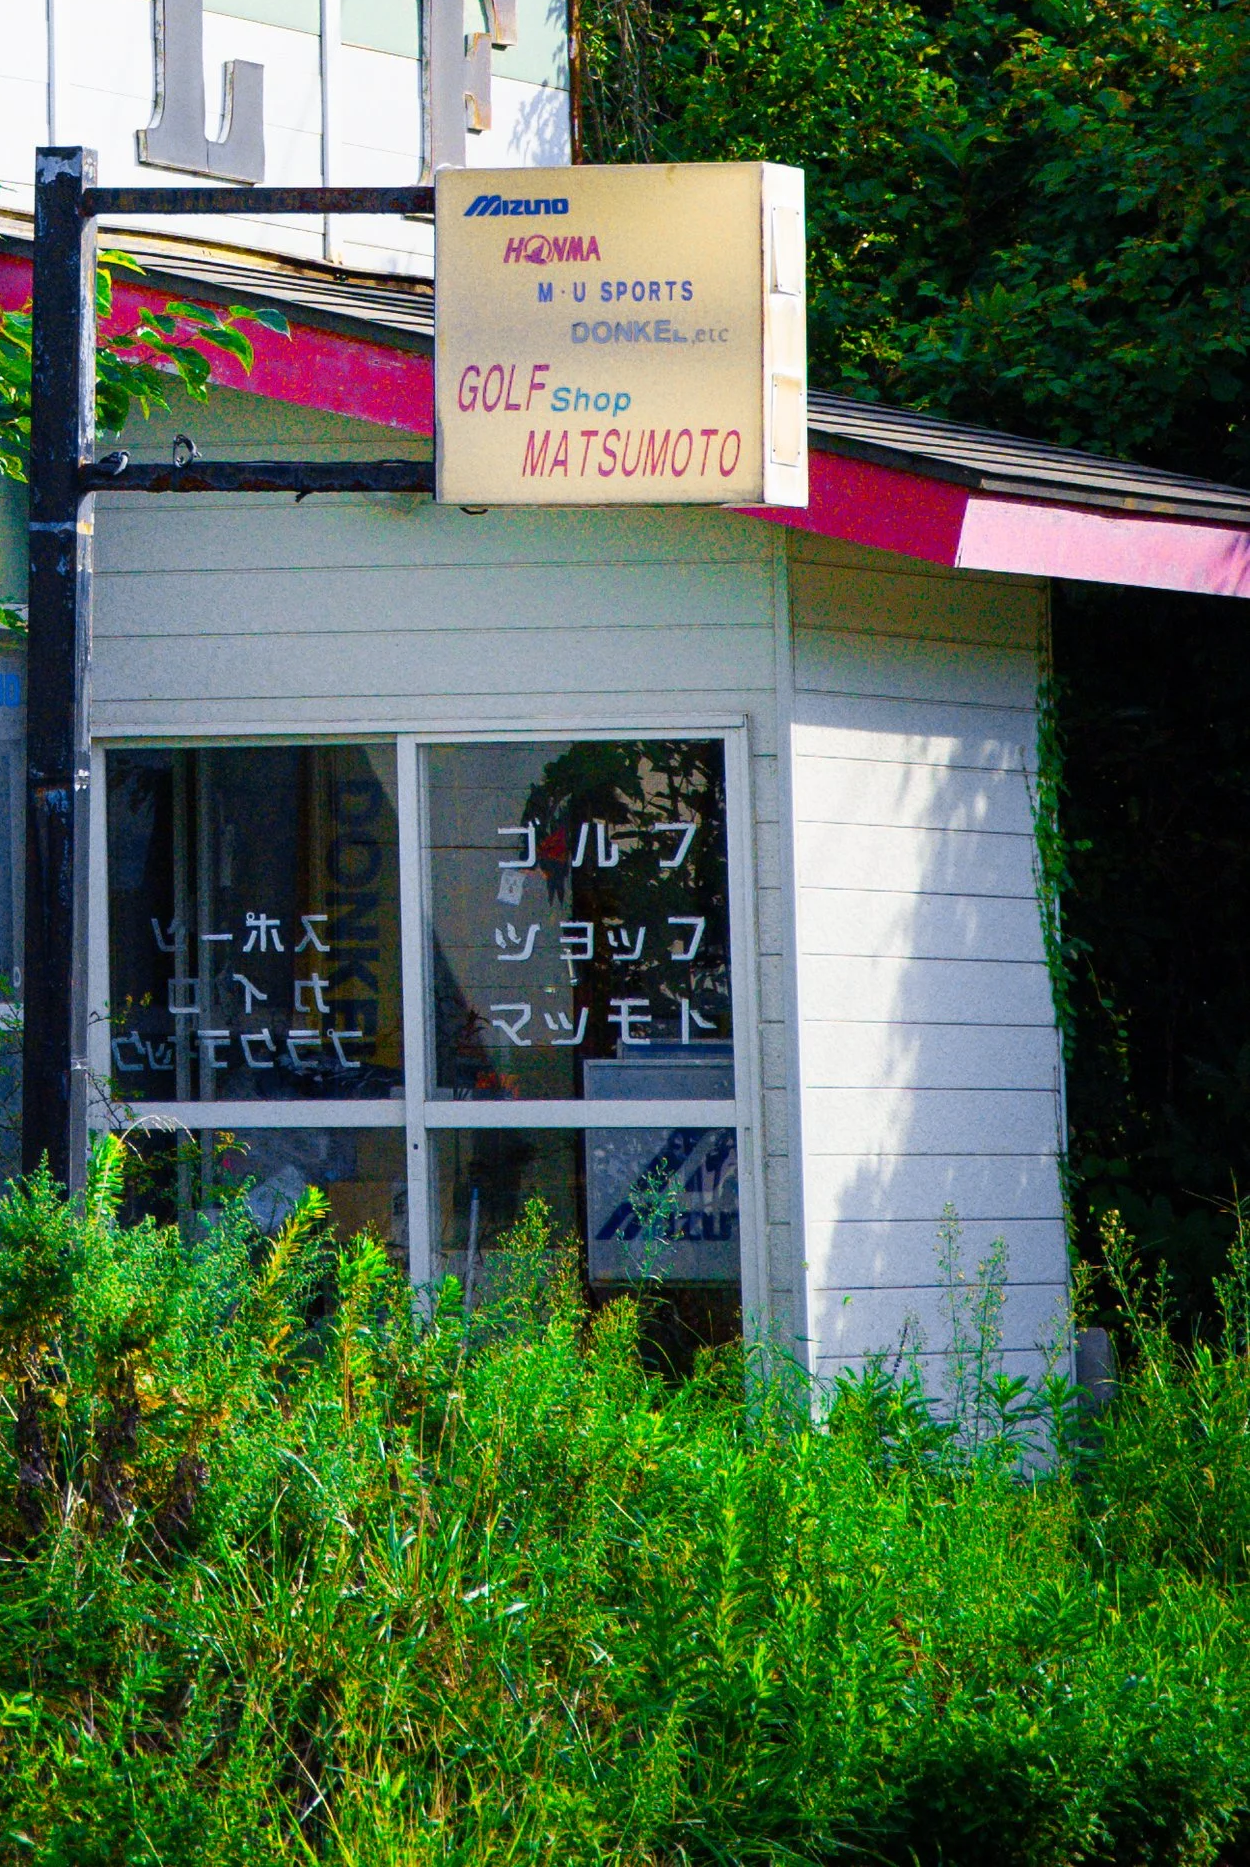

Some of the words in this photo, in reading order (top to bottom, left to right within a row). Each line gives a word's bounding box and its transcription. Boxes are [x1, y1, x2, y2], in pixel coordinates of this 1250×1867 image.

[503, 234, 602, 265] HONMA
[600, 279, 694, 303] SPORTS
[458, 363, 550, 413] GOLF
[550, 386, 632, 418] Shop
[521, 428, 742, 478] MATSUMOTO
[489, 997, 718, 1047] マツモト
